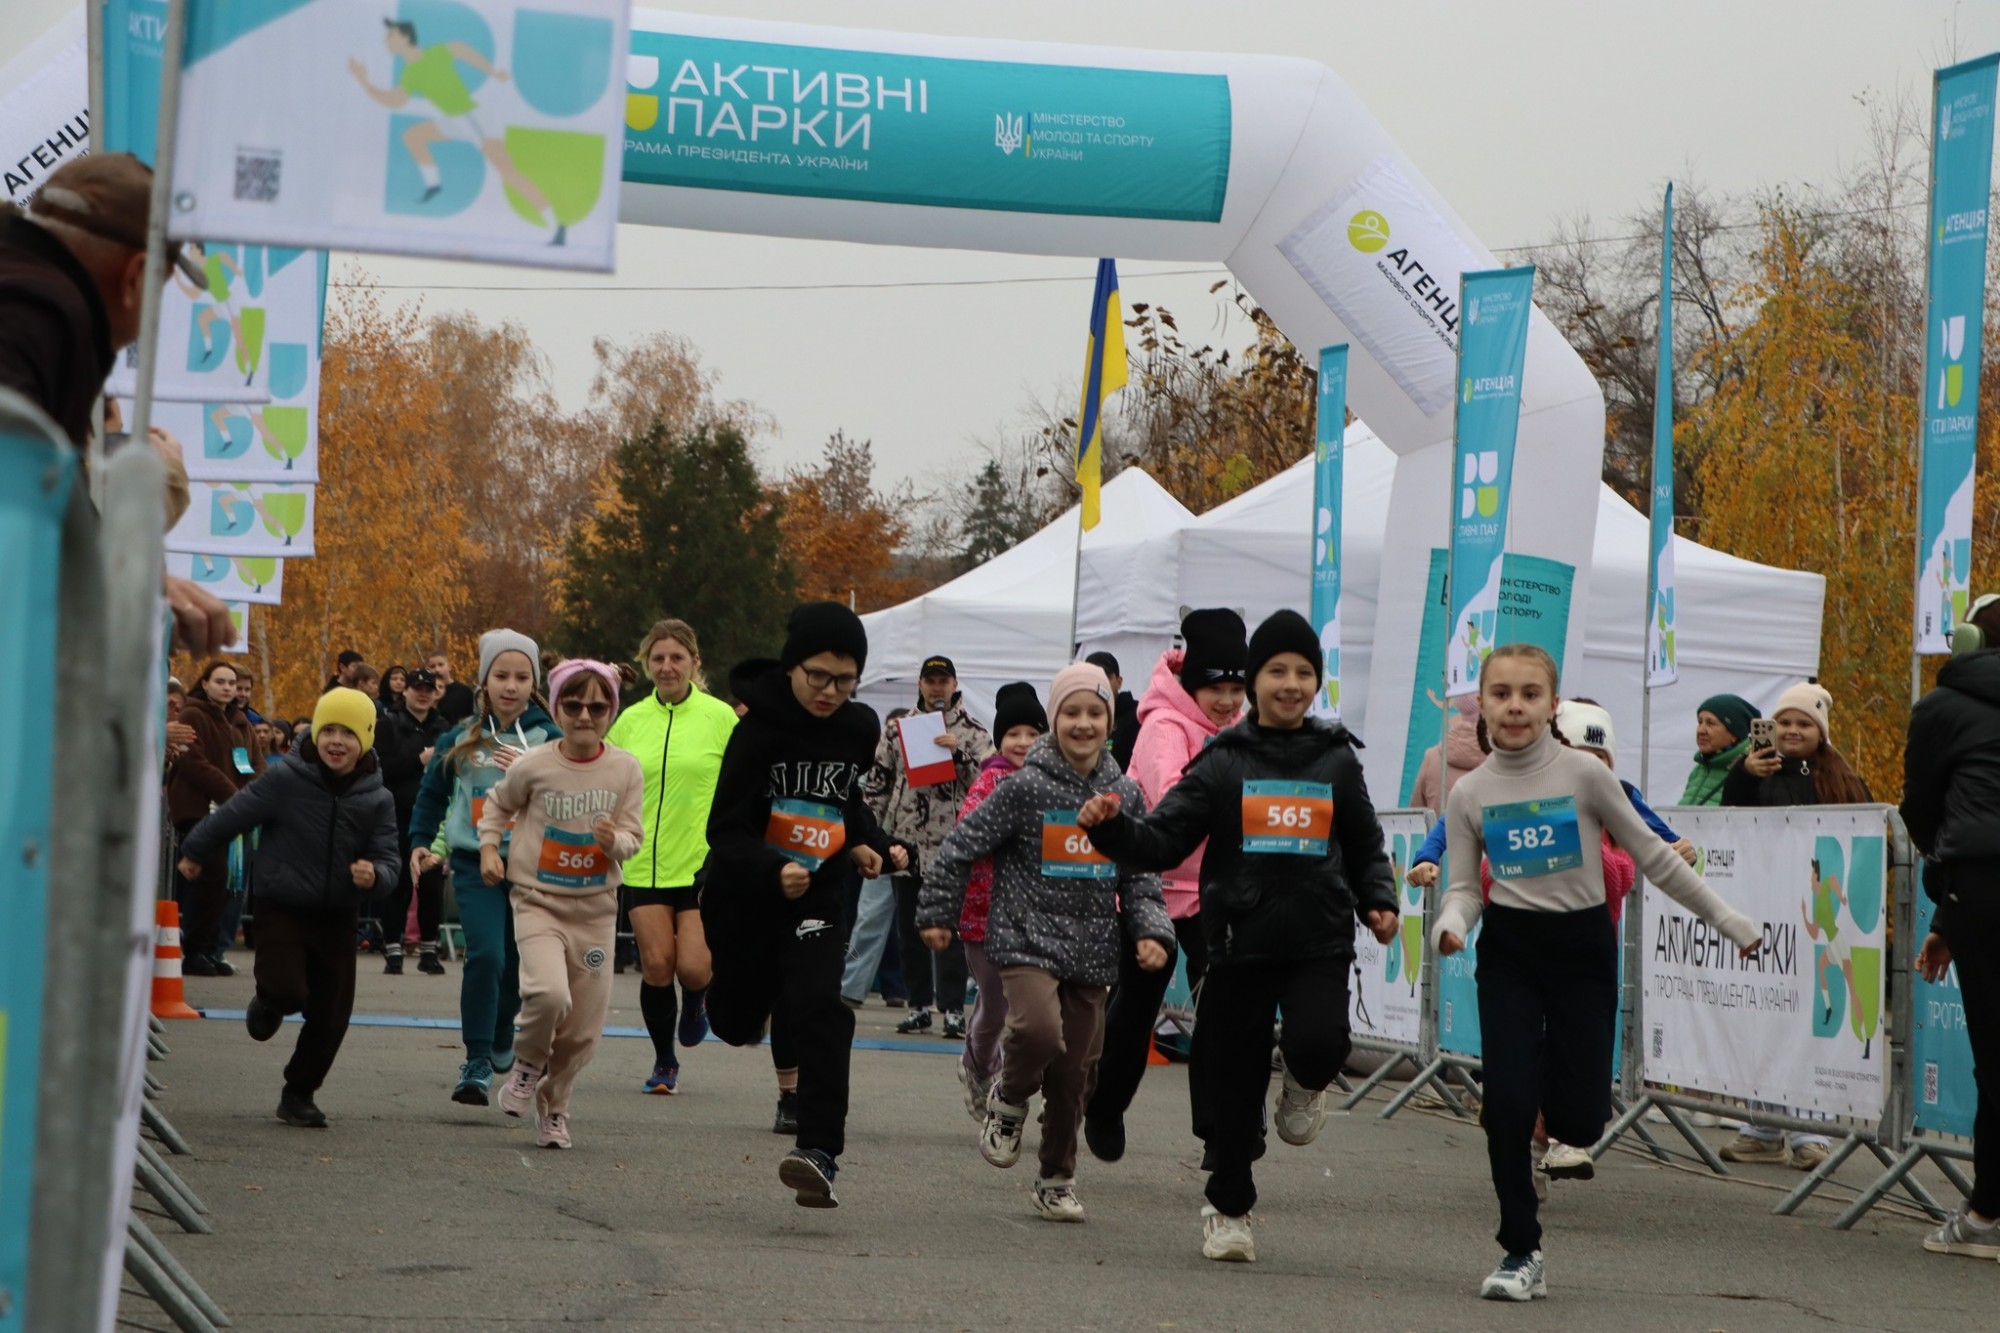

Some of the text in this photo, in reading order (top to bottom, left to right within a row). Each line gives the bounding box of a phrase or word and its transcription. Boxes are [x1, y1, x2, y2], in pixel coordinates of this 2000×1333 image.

[670, 59, 927, 114] АКТИВНІ
[667, 96, 871, 150] ПАРКИ
[1033, 112, 1126, 128] МІНІСТЕРСТВО
[1033, 129, 1154, 147] МОЛОДІ ТА СПОРТУ
[624, 139, 868, 171] РАМА ПРЕЗИДЕНТА УКРАЇНИ
[1032, 148, 1083, 161] УКРАЇНИ
[1376, 261, 1411, 301] МАСОВОГО
[1387, 248, 1458, 336] АГЕНЦ
[1474, 375, 1514, 392] АГЕНЦІЯ
[1500, 577, 1561, 595] ІНСТЕРСТВО
[1498, 591, 1531, 604] ОЛОДІ
[1503, 606, 1543, 619] СПОРТУ
[544, 790, 618, 820] VIRGINIA
[1267, 806, 1312, 828] 565
[789, 825, 830, 848] 520
[1065, 834, 1095, 854] 60
[1508, 825, 1556, 851] 582
[557, 851, 594, 869] 566
[1706, 849, 1735, 869] АГЕНЦІЯ
[1654, 974, 1800, 1013] ПРОГРАМА ПРЕЗИДЕНТА УКРАЇНИ
